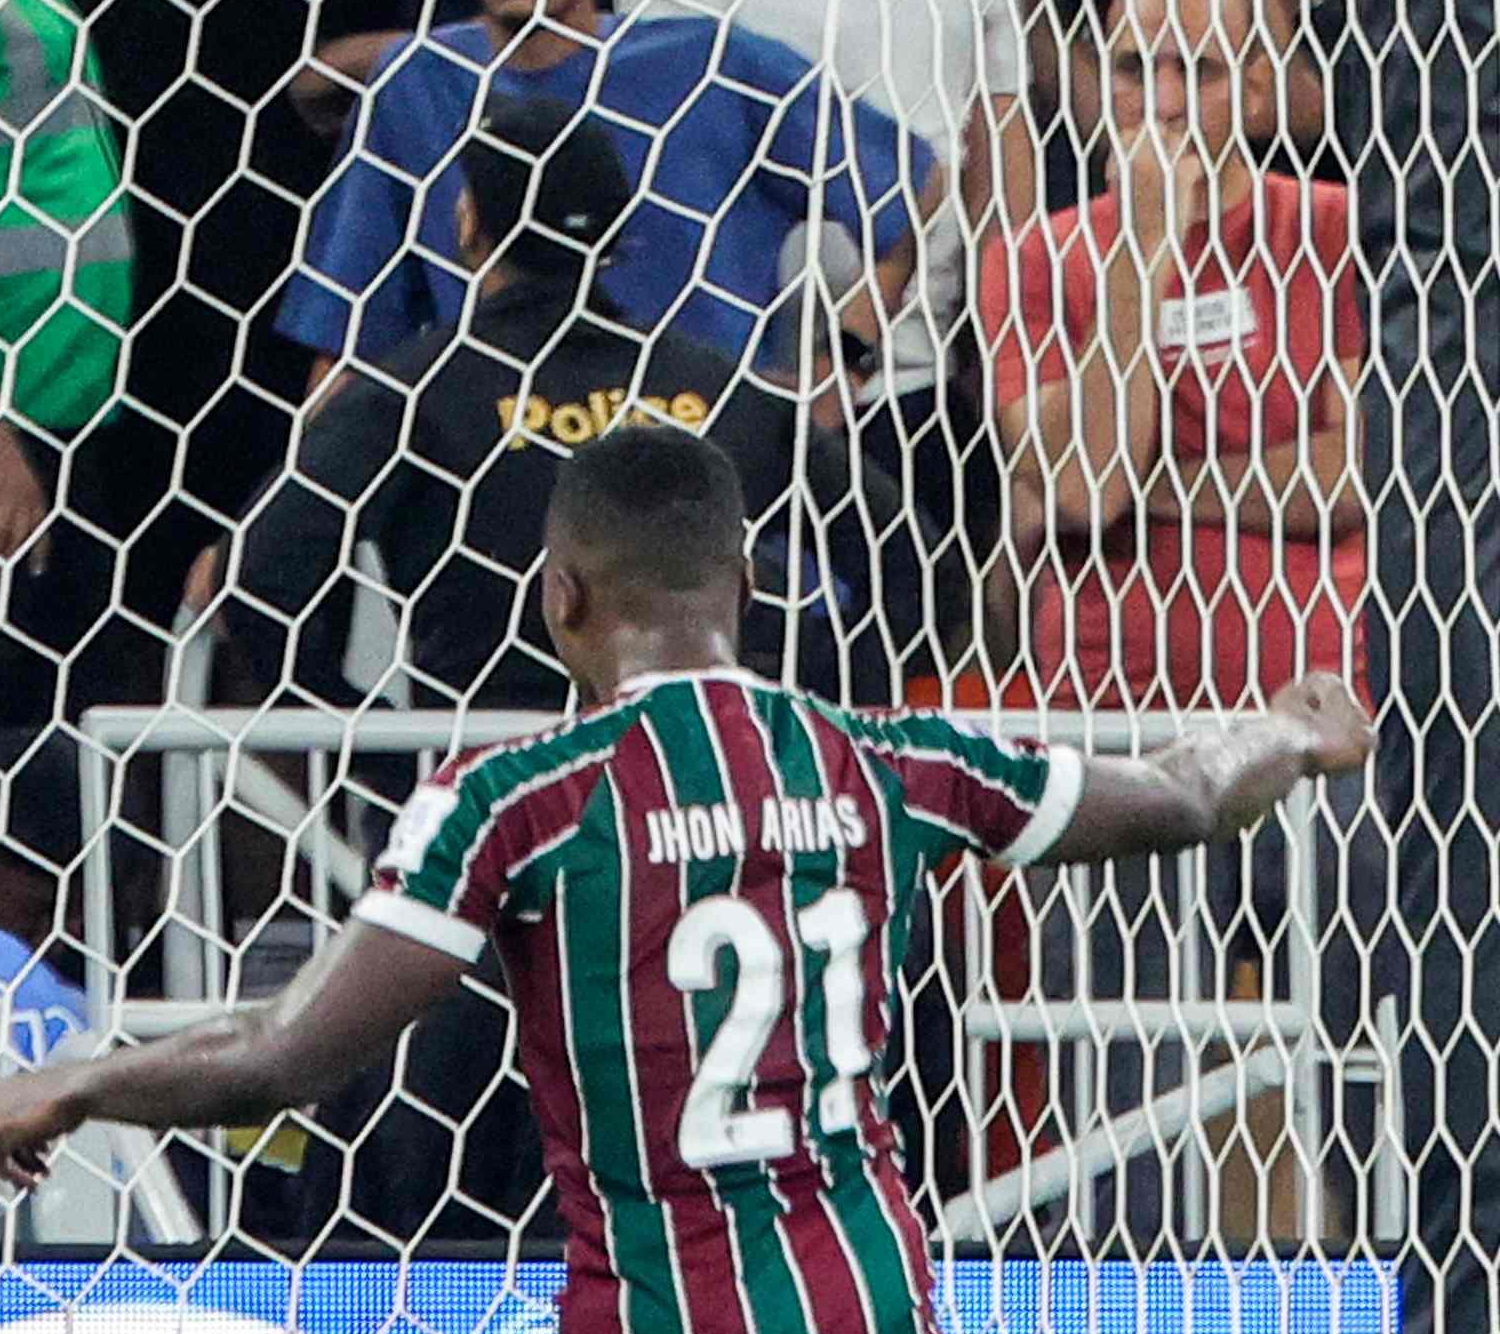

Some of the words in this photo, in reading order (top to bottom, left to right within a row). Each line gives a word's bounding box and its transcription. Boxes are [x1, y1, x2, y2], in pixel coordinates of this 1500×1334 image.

[645, 803, 747, 865] JHON
[761, 793, 867, 853] ARIAS
[666, 886, 870, 1169] 21
